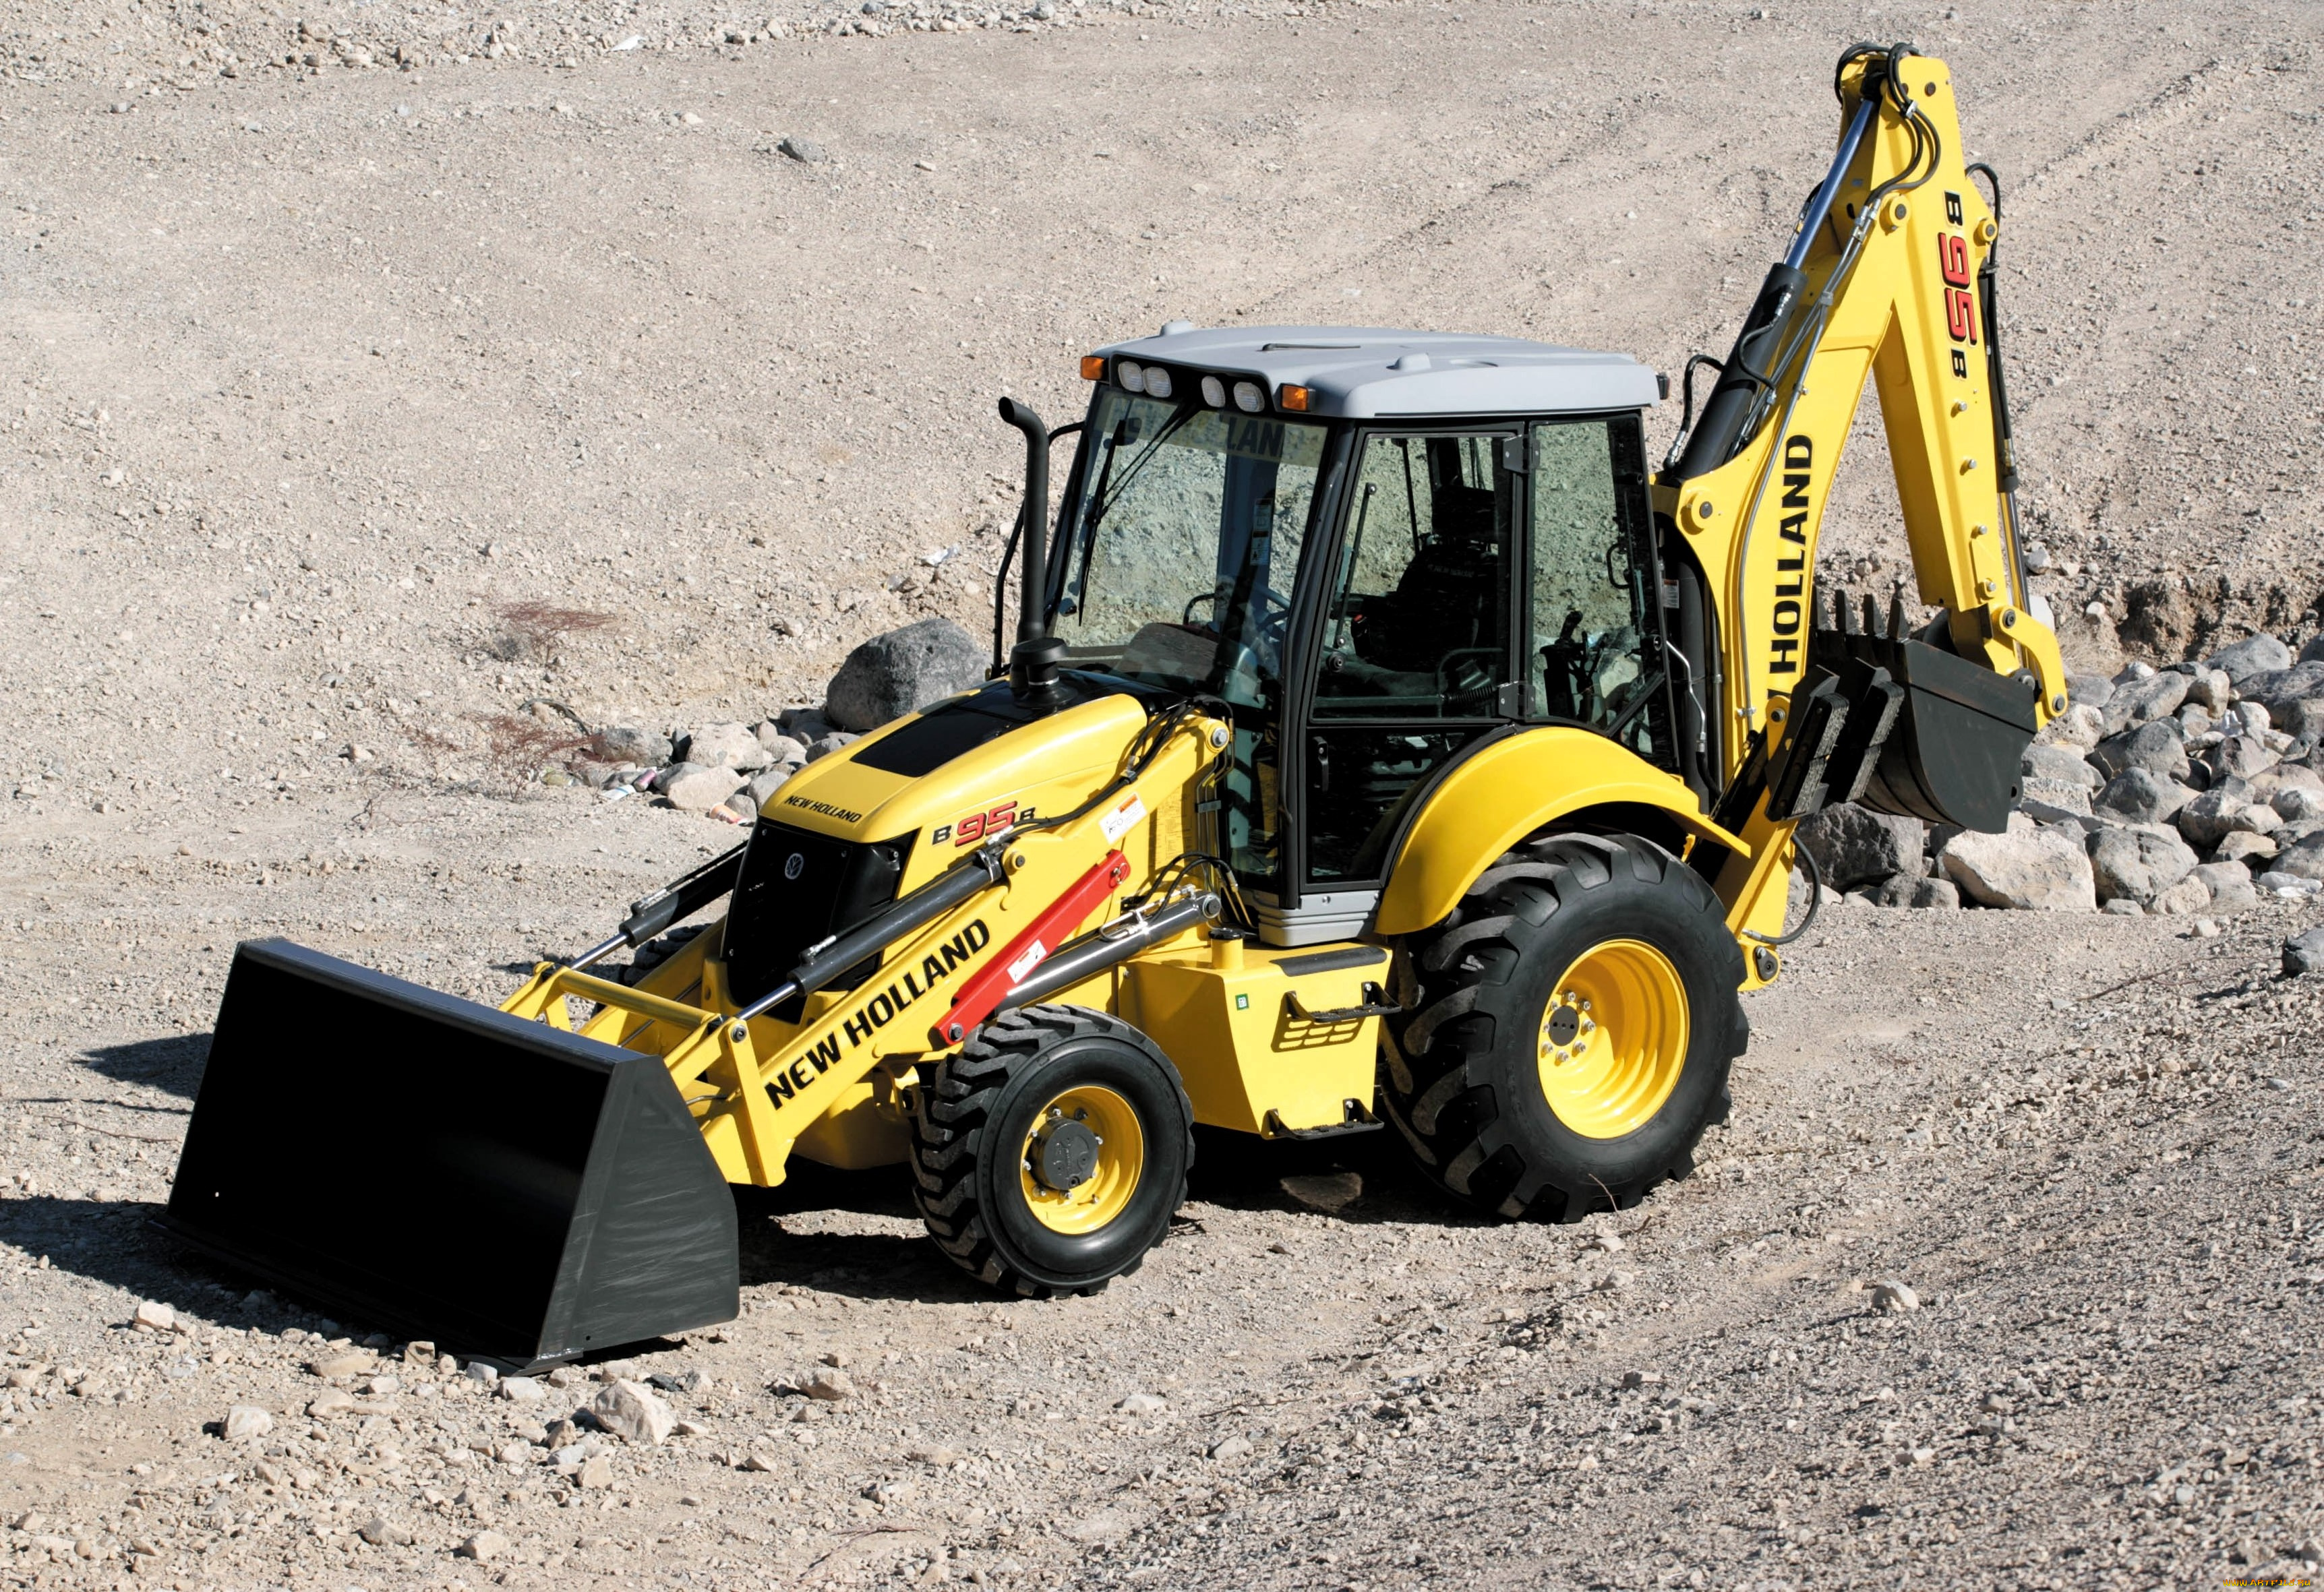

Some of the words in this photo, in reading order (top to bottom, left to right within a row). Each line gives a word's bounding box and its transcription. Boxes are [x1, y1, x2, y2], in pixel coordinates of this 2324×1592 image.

[1769, 434, 1813, 673] HOLLAND
[784, 795, 813, 808] NEW
[809, 801, 862, 822] HOLLAND
[764, 1031, 842, 1110] NEW
[842, 919, 990, 1047] HOLLAND
